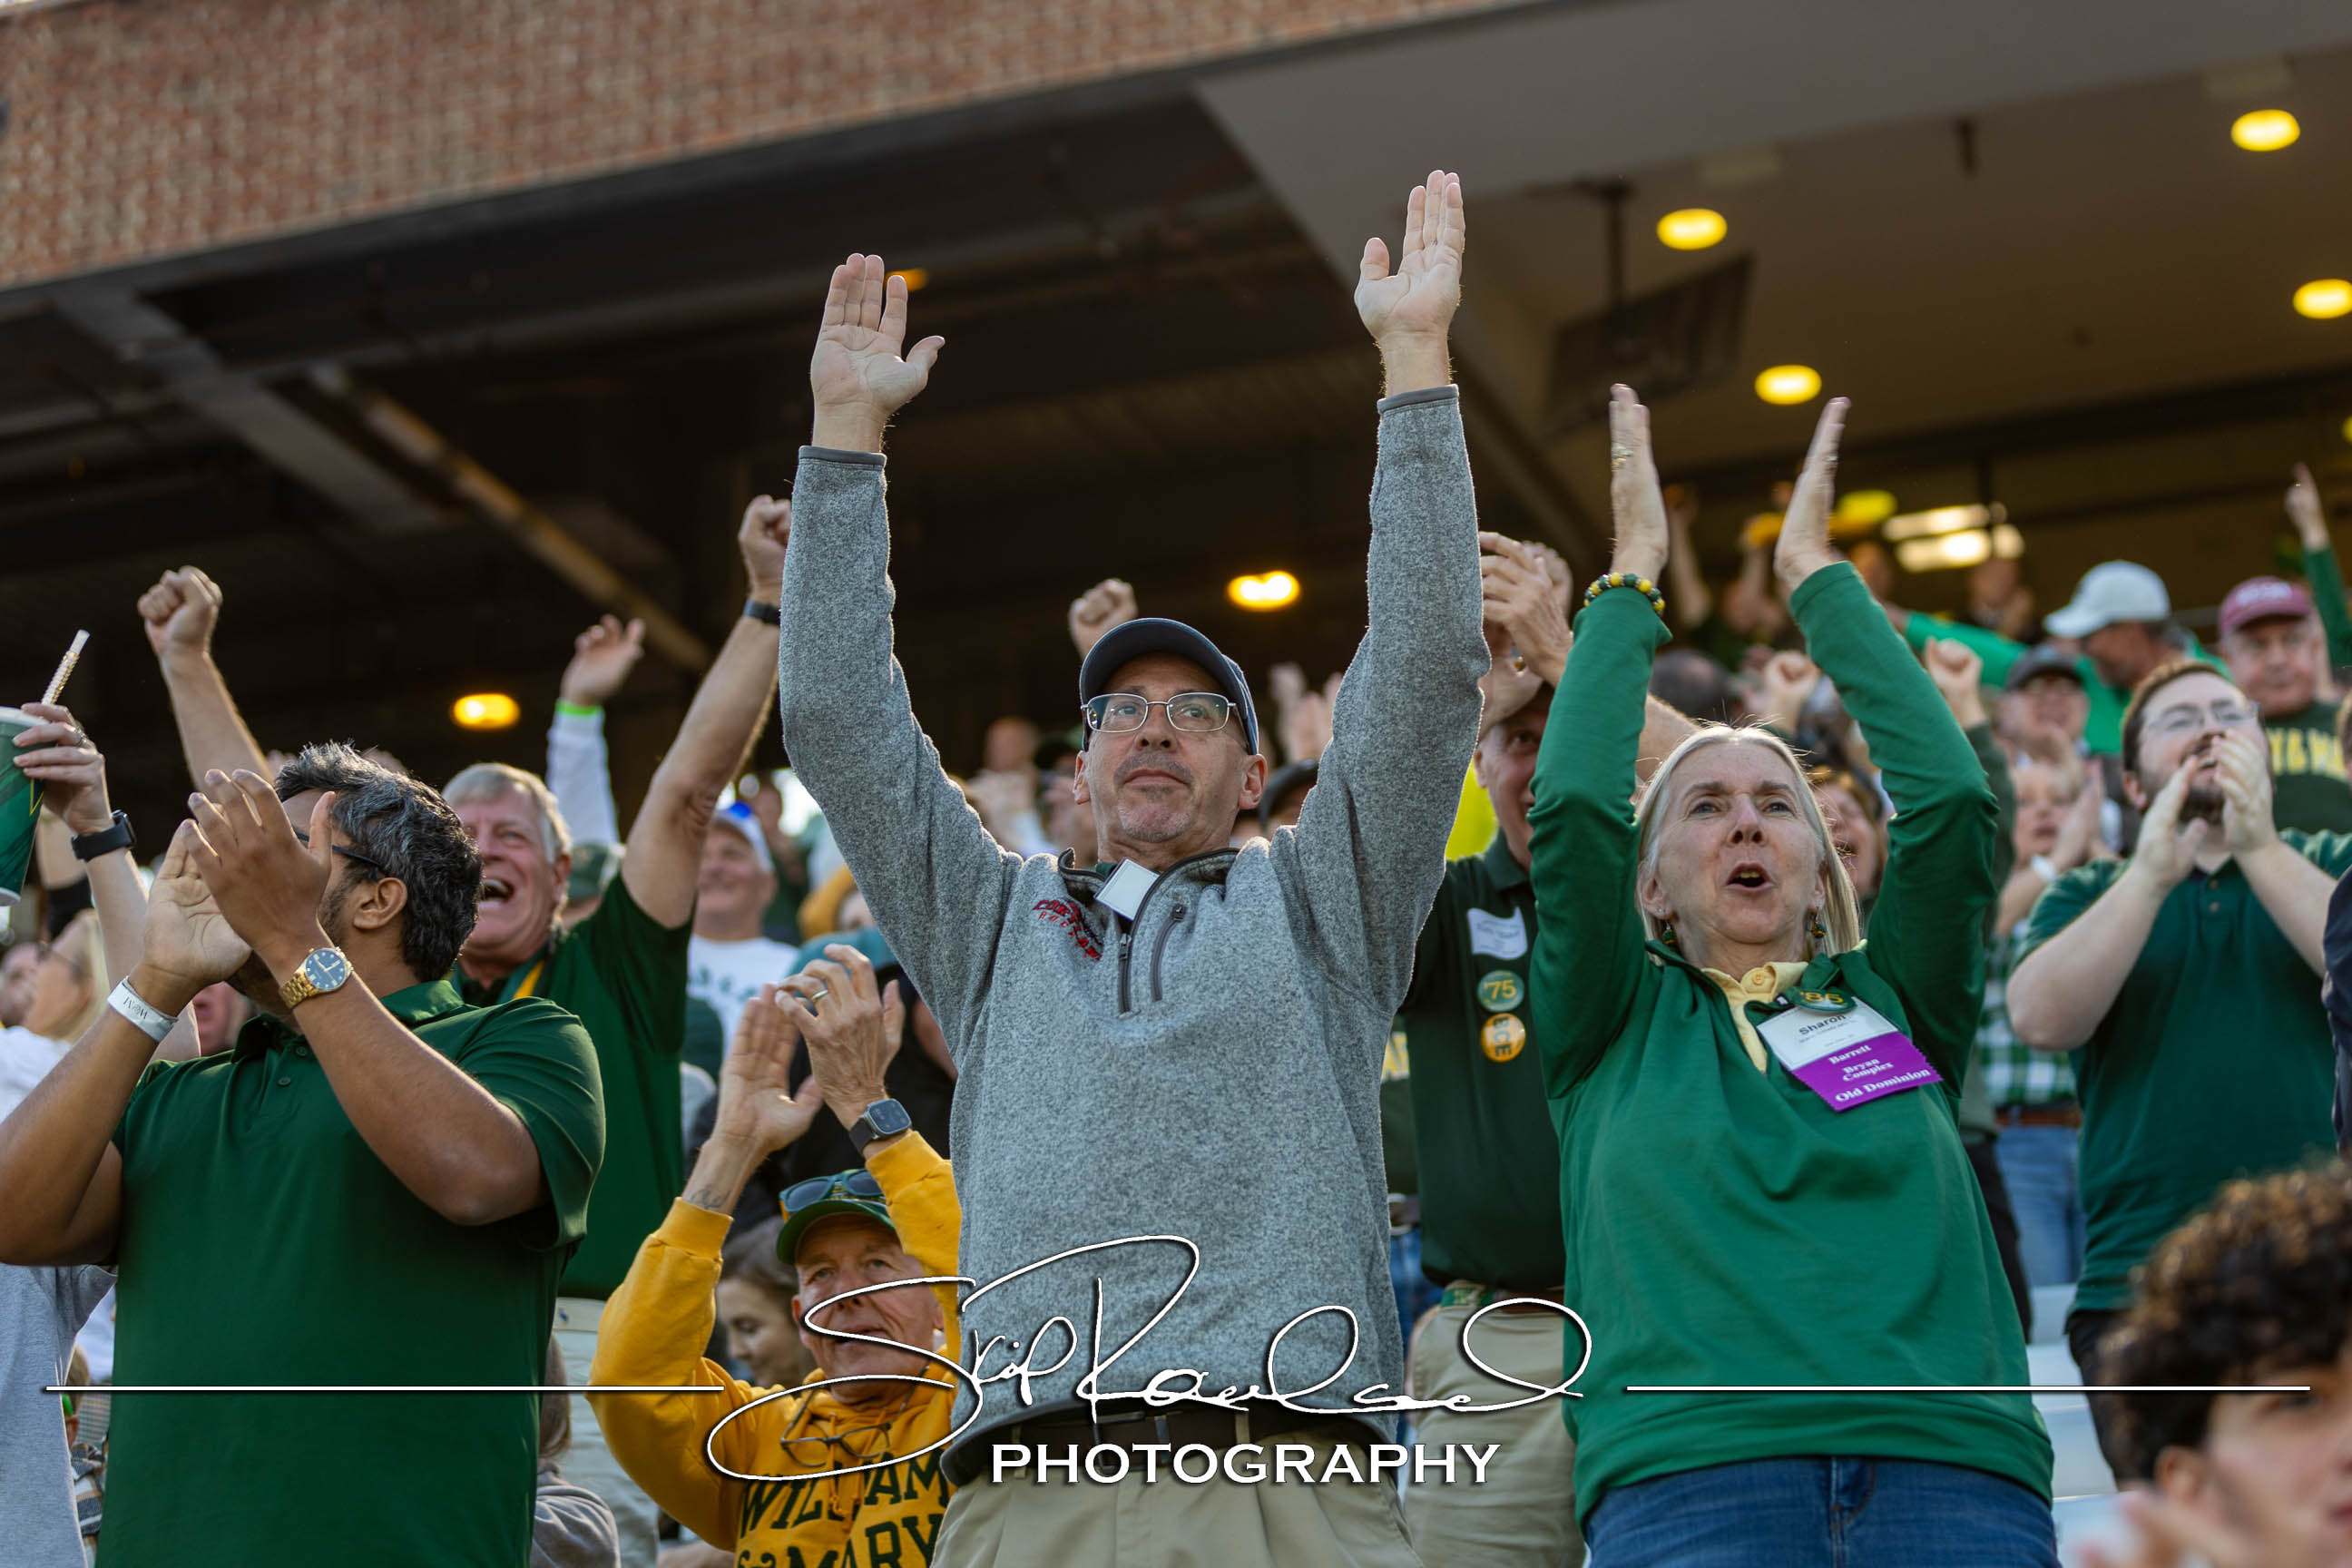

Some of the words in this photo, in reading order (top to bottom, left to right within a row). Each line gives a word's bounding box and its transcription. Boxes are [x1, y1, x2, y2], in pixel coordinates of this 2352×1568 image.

[1798, 1014, 1847, 1036] Sharon
[1828, 1044, 1872, 1064] Barrett
[1842, 1058, 1880, 1074] Bryan
[1842, 1062, 1895, 1082] Complex
[1835, 1087, 1864, 1102] Old
[1863, 1069, 1932, 1093] Dominion
